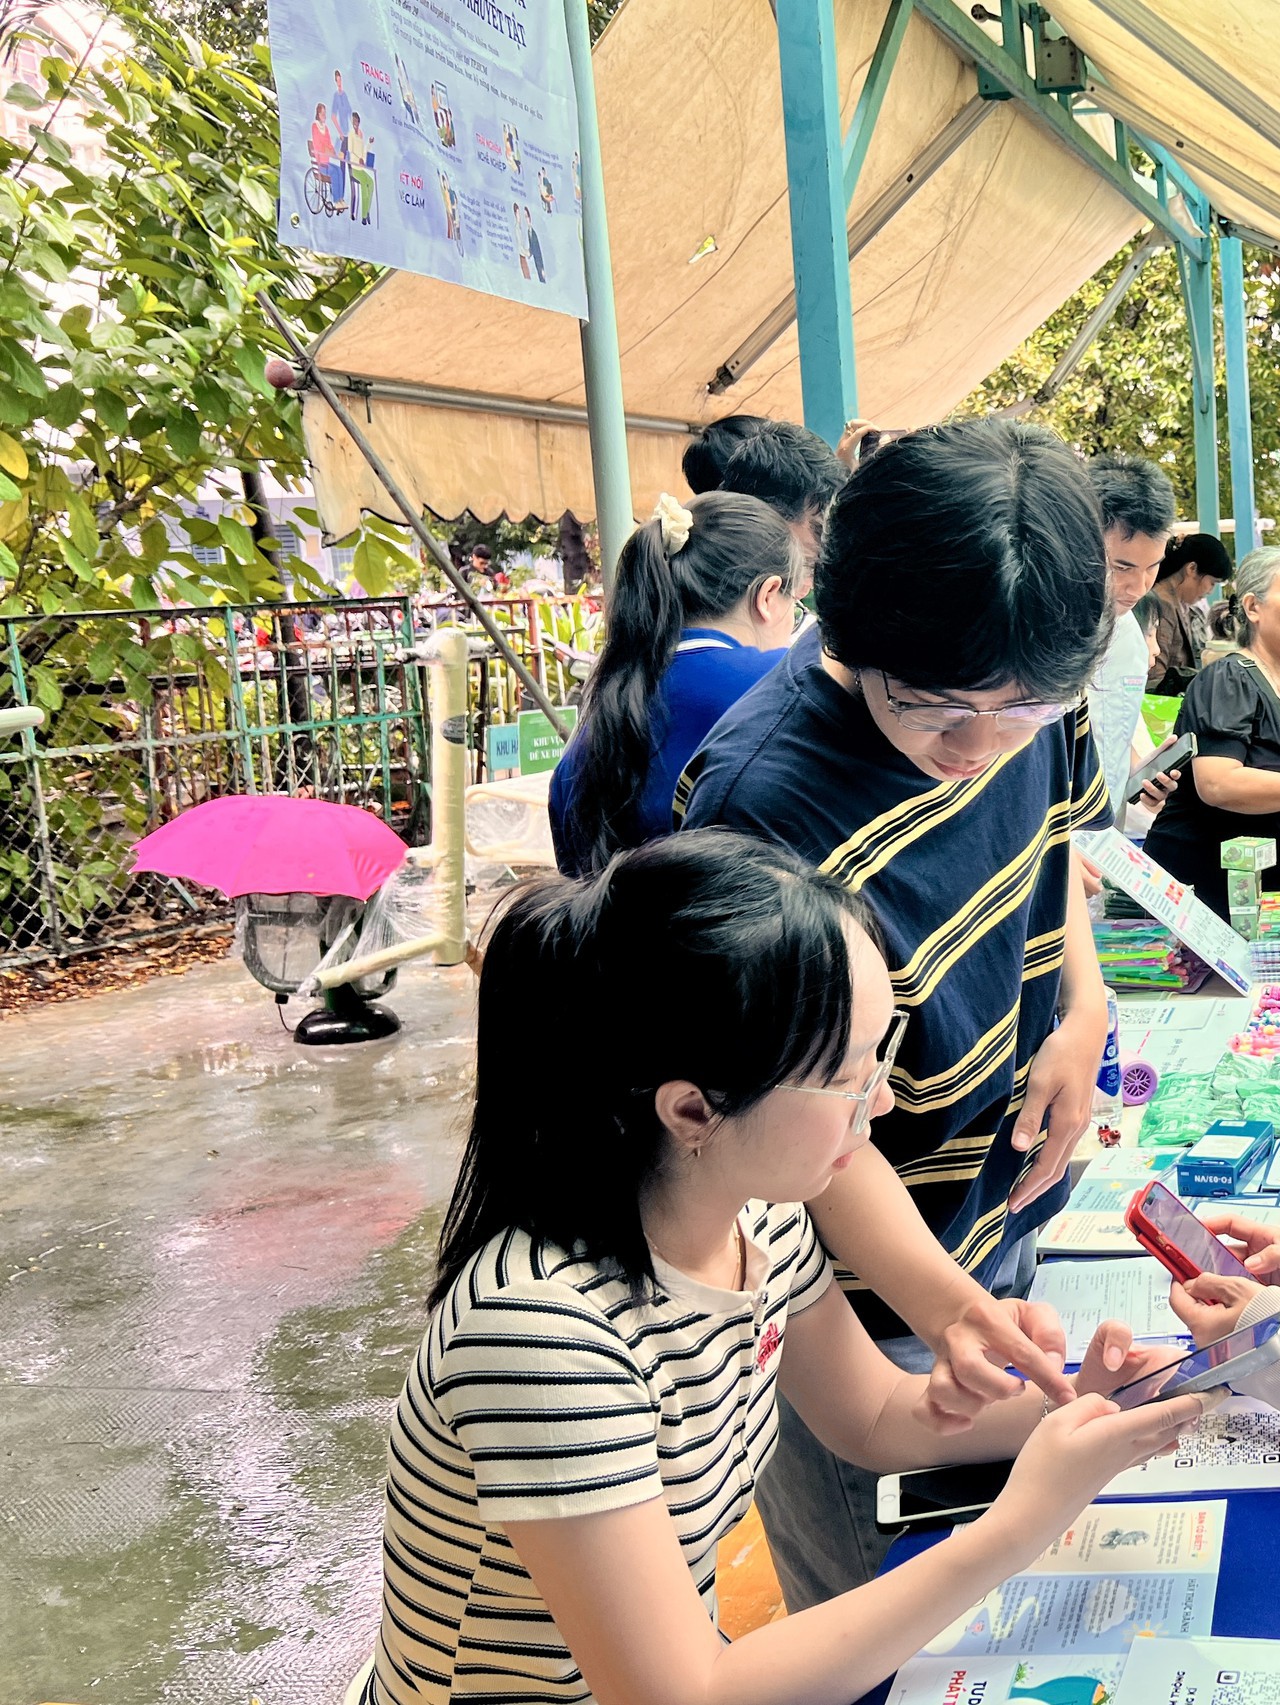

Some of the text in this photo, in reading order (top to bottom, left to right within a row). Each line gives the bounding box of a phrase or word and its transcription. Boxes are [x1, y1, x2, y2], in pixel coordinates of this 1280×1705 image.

[504, 11, 527, 50] TẬT
[360, 61, 383, 82] TRANG
[496, 740, 509, 756] KHU
[533, 736, 549, 747] KHU
[1194, 1174, 1232, 1184] FO-03/VN
[1180, 1611, 1195, 1633] HÀNH
[945, 1670, 967, 1699] PHÁT
